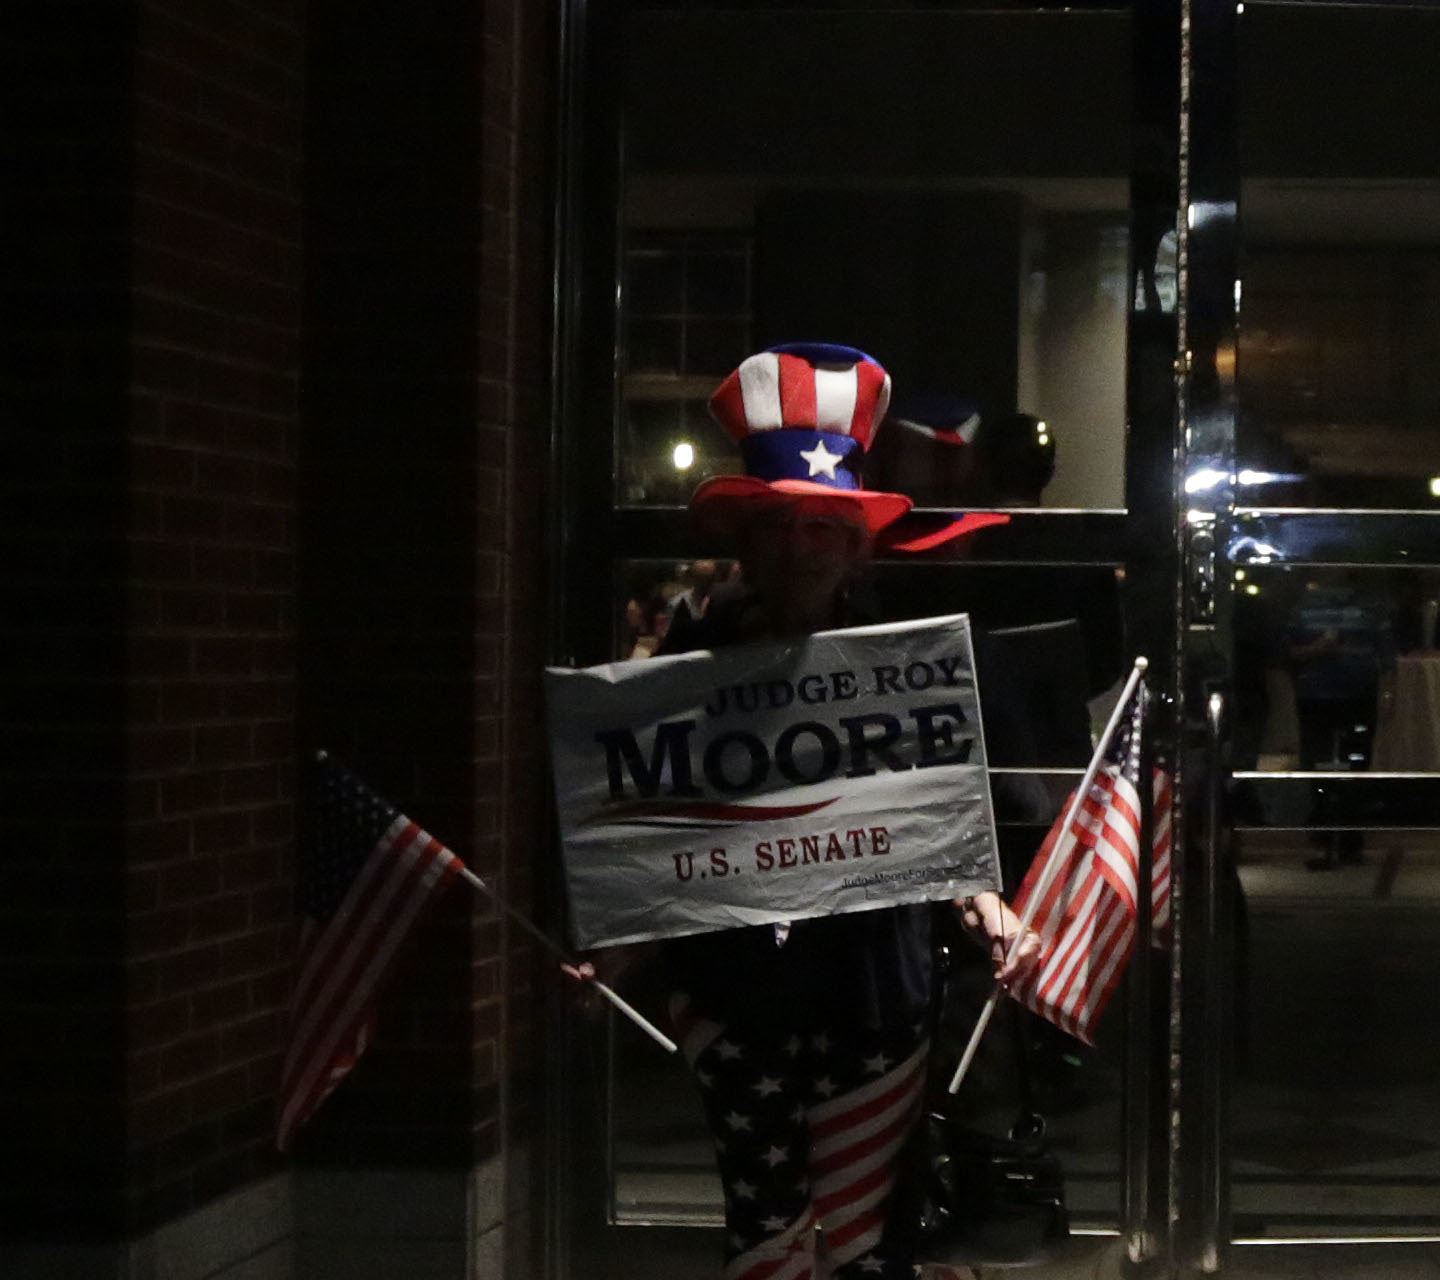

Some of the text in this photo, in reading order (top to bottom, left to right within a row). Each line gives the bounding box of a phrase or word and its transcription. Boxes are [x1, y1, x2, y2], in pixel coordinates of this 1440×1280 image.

[705, 655, 964, 718] JUDGE ROY
[594, 703, 973, 802] MOORE
[672, 825, 893, 883] U.S. SENATE
